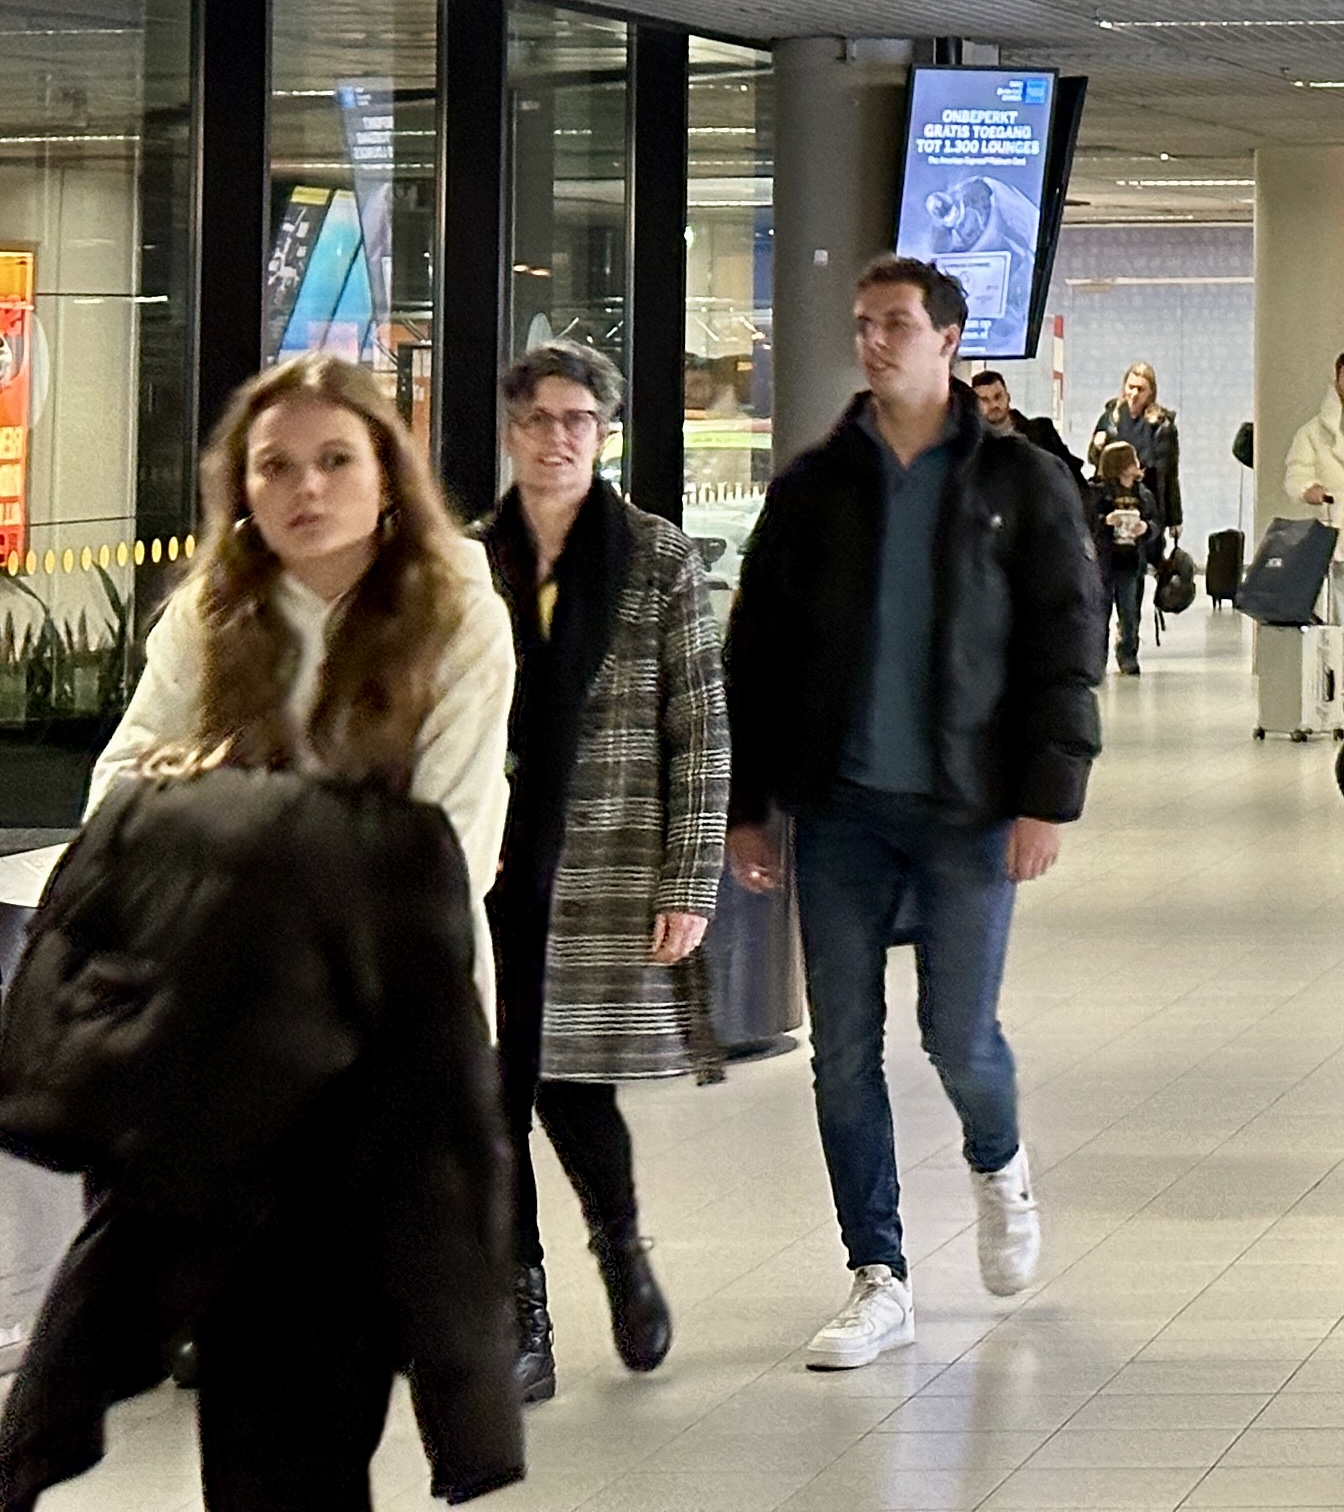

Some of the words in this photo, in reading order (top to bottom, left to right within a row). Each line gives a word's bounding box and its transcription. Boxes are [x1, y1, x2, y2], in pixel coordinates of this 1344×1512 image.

[942, 109, 1018, 124] ONBEPERKT
[924, 124, 970, 138] GRATIS
[916, 139, 942, 153] TOT
[981, 140, 1040, 155] LOUNGES
